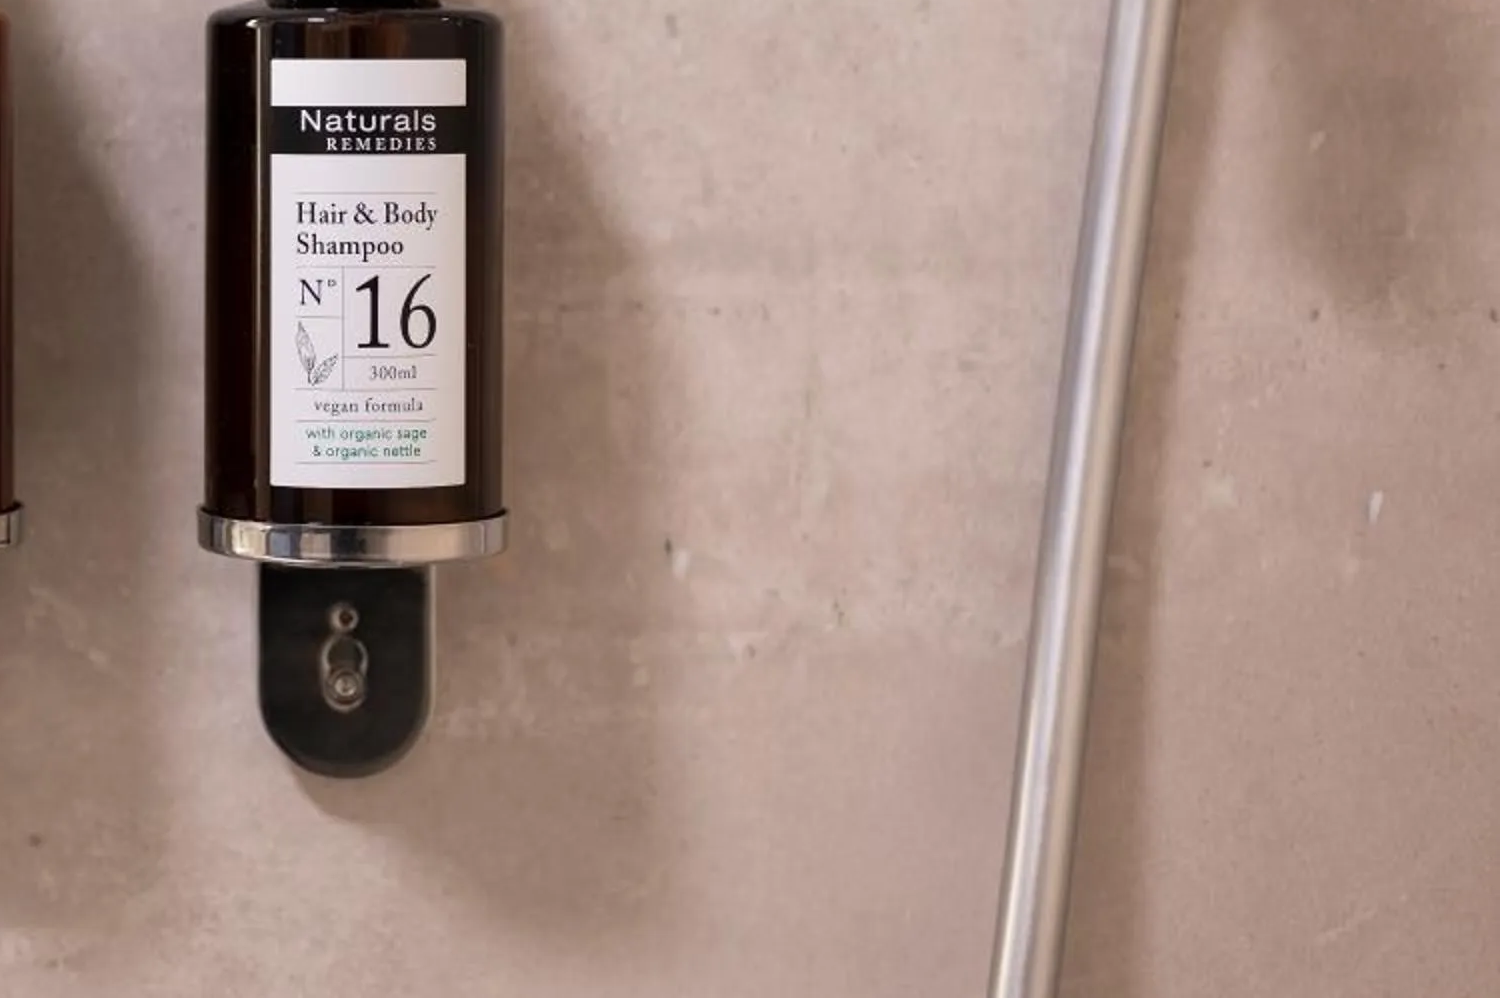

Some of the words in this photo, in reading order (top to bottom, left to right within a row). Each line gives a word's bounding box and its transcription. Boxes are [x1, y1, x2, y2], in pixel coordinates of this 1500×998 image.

[300, 109, 437, 133] Naturals
[326, 137, 437, 151] REMEDIES
[296, 201, 348, 225] Hair
[353, 201, 376, 225] &
[383, 201, 438, 231] Body
[296, 231, 404, 262] Shampoo
[355, 273, 437, 349] 16
[369, 365, 418, 381] 300ml
[314, 400, 359, 416] vegan
[364, 397, 424, 412] formula
[305, 427, 336, 440] with
[339, 427, 395, 442] organic
[396, 429, 428, 443] sage
[311, 446, 321, 457] &
[325, 445, 379, 460] organic
[383, 444, 422, 457] nettle
